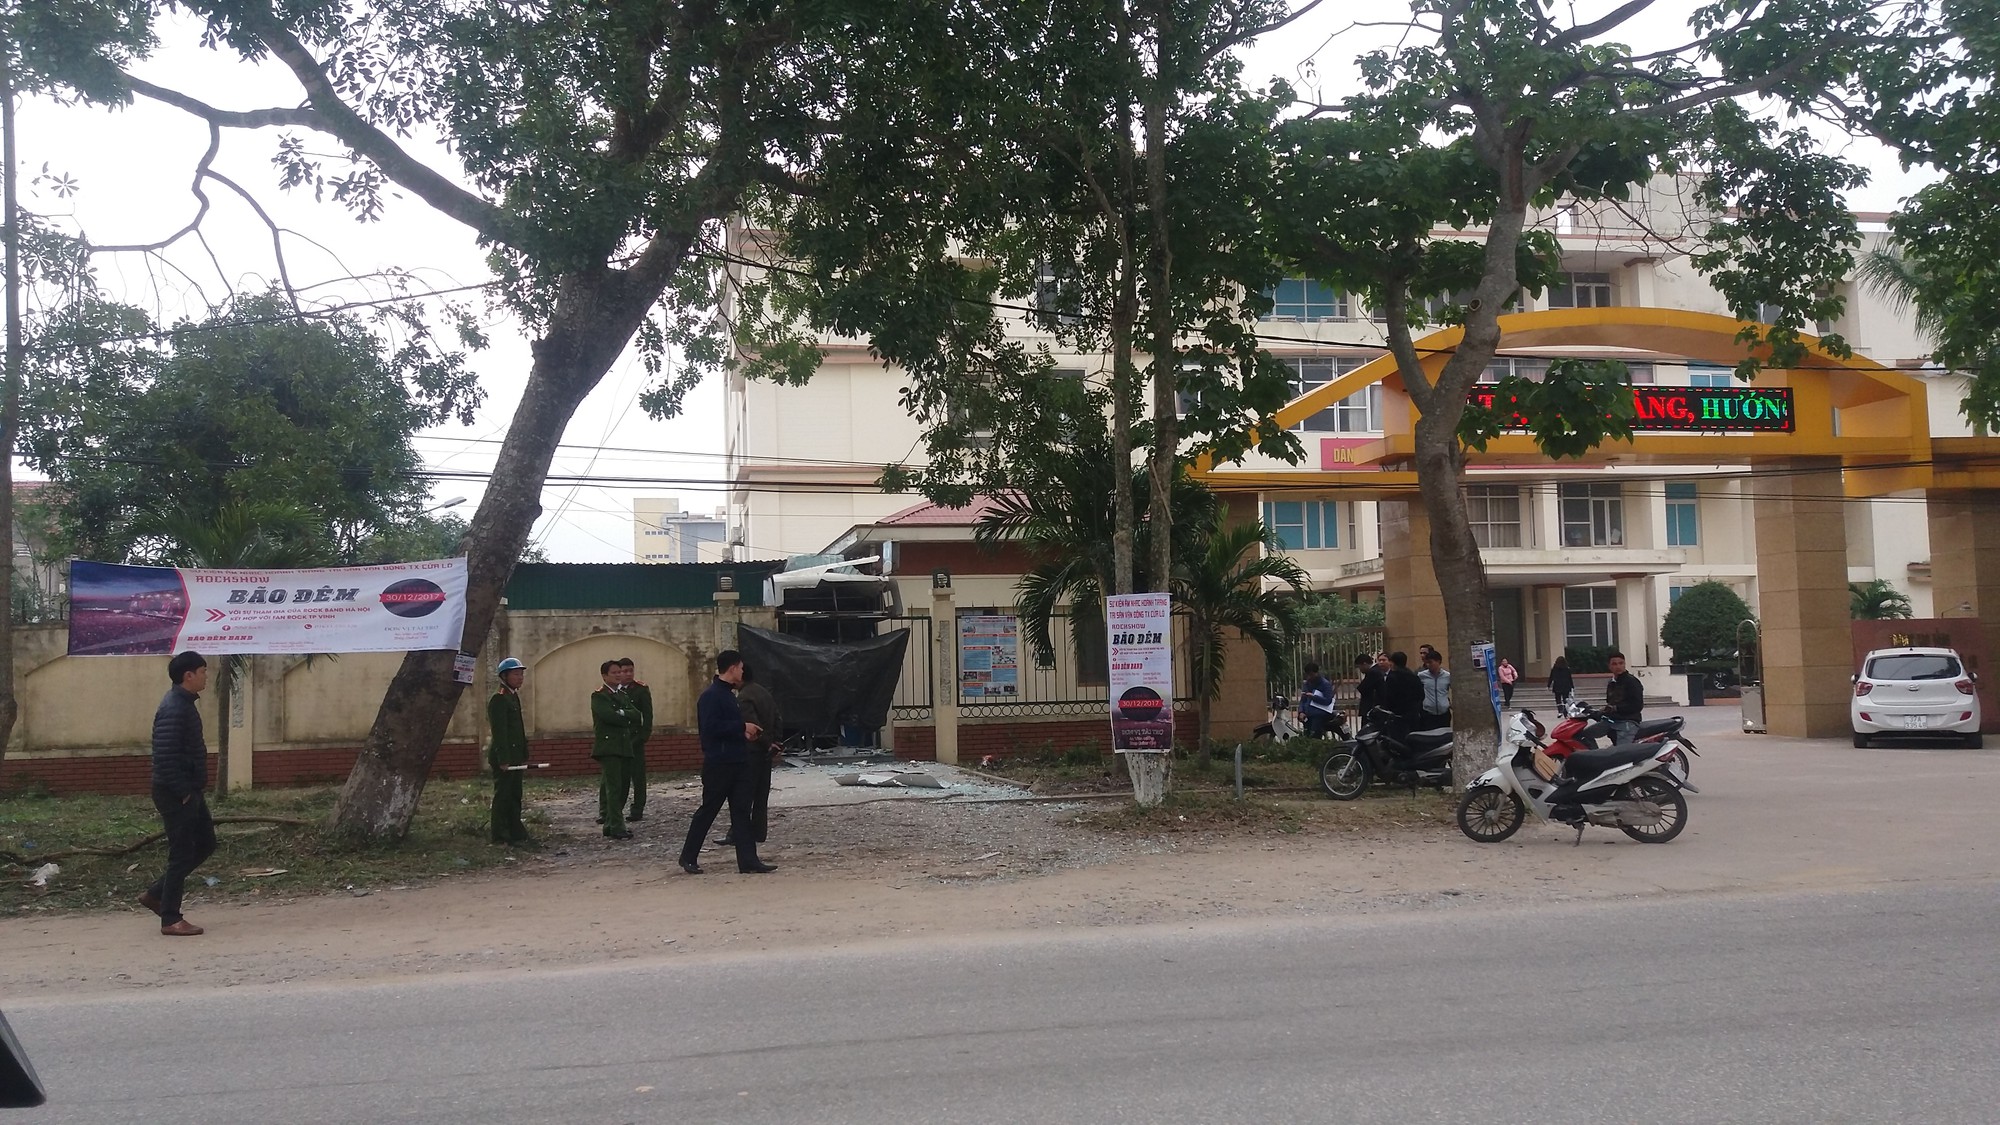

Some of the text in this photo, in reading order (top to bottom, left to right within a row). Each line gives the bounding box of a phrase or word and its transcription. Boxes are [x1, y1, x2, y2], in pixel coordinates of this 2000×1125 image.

[1700, 392, 1786, 420] HƯỚN
[195, 575, 270, 584] ROCKSHOW
[226, 585, 360, 604] BÃO ĐÊM
[386, 593, 440, 601] 30/12/2017
[1112, 630, 1163, 645] BÃO ĐÊM
